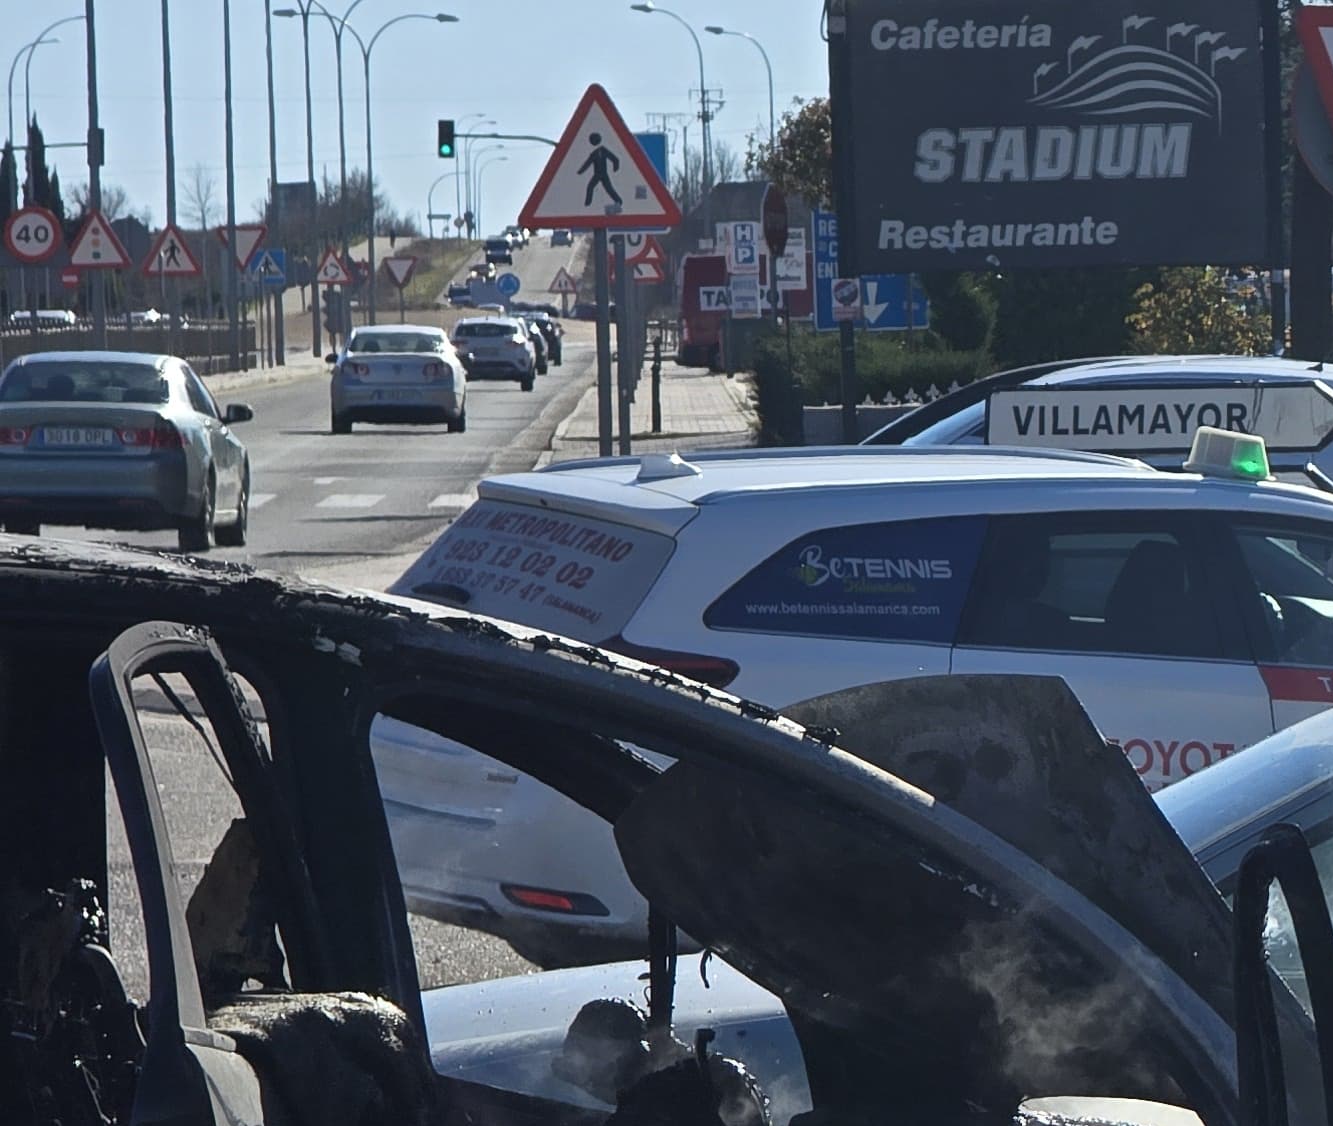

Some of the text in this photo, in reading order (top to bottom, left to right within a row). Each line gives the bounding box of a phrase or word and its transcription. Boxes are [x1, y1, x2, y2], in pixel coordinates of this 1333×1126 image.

[870, 15, 1052, 51] Cafetería
[913, 123, 1193, 183] STADIUM
[15, 224, 49, 244] 40
[877, 216, 1119, 250] Restaurante
[1012, 402, 1249, 437] VILLAMAYOR
[486, 510, 635, 563] METROPOLITANO
[486, 544, 523, 569] 12
[519, 550, 557, 578] 02
[555, 560, 595, 590] 02
[797, 544, 953, 587] BeTENNIS
[518, 580, 546, 602] 47
[1106, 737, 1250, 778] OYOT
